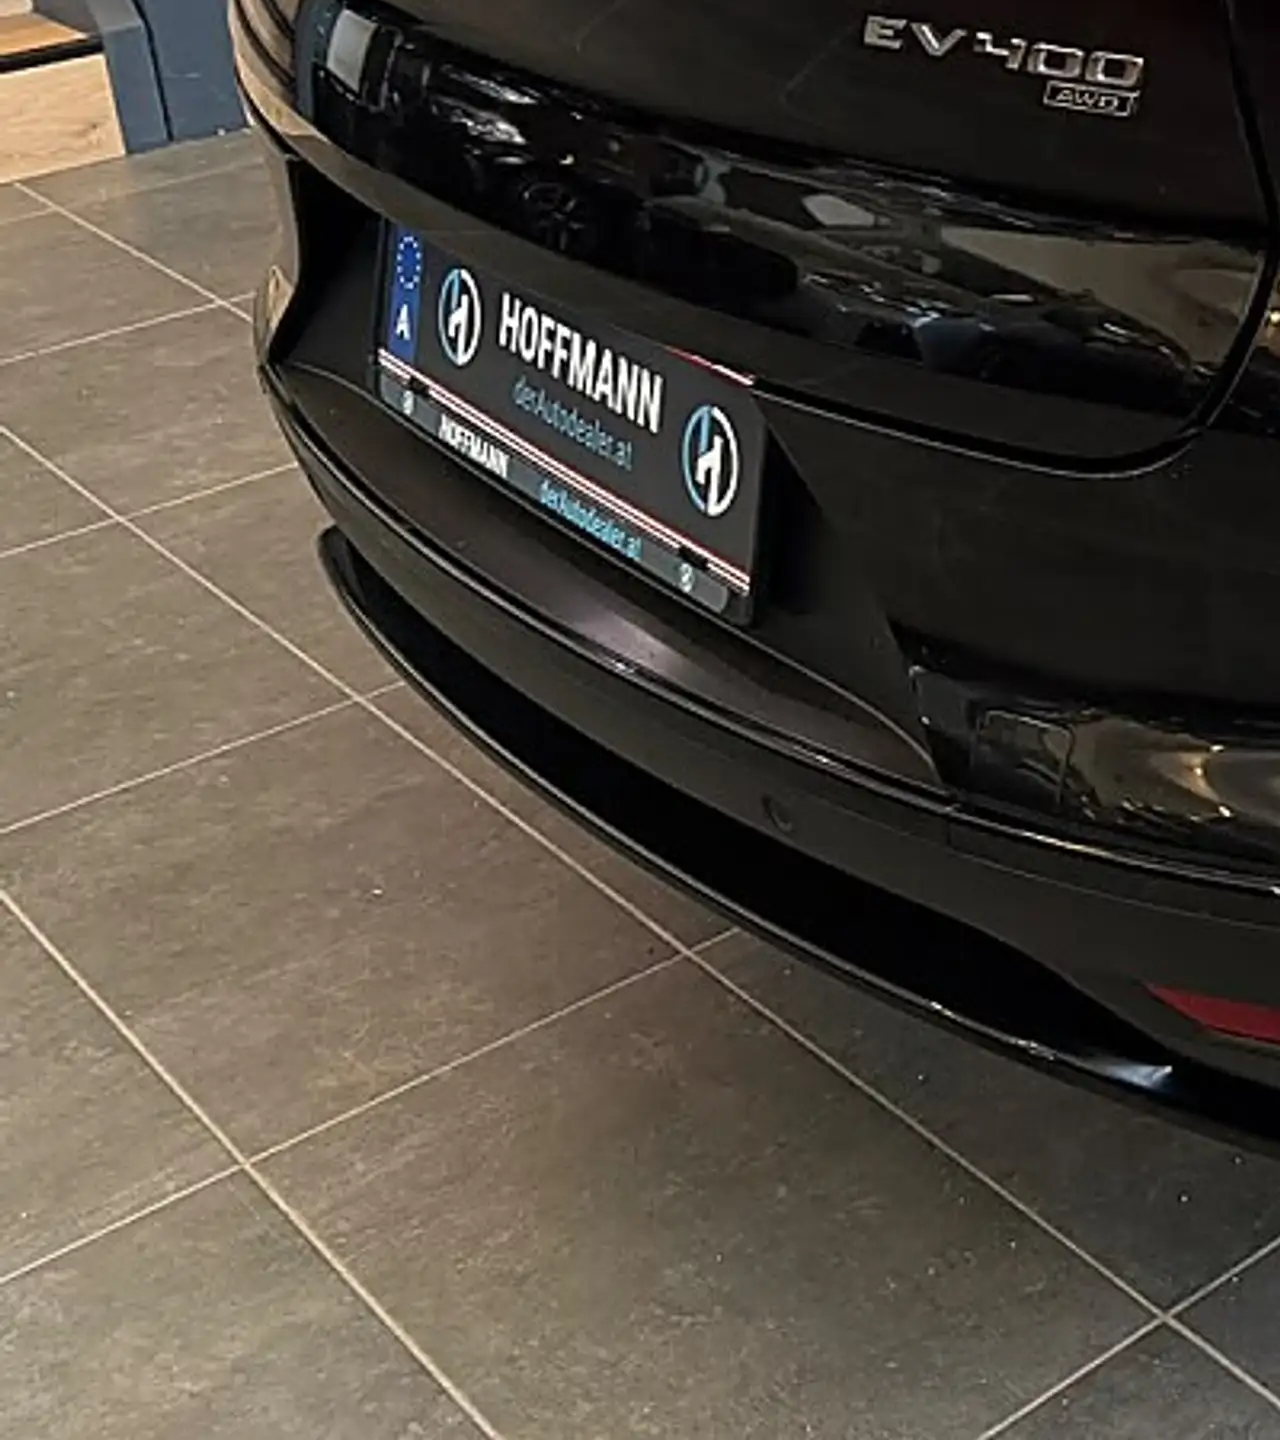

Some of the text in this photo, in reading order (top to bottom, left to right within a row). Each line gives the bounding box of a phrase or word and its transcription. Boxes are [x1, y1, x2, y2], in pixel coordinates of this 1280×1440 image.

[863, 15, 1145, 87] EV400
[1055, 89, 1119, 109] AWD
[395, 303, 411, 341] A
[499, 291, 664, 434] HOFFMANN
[438, 413, 511, 478] HOFFMANN
